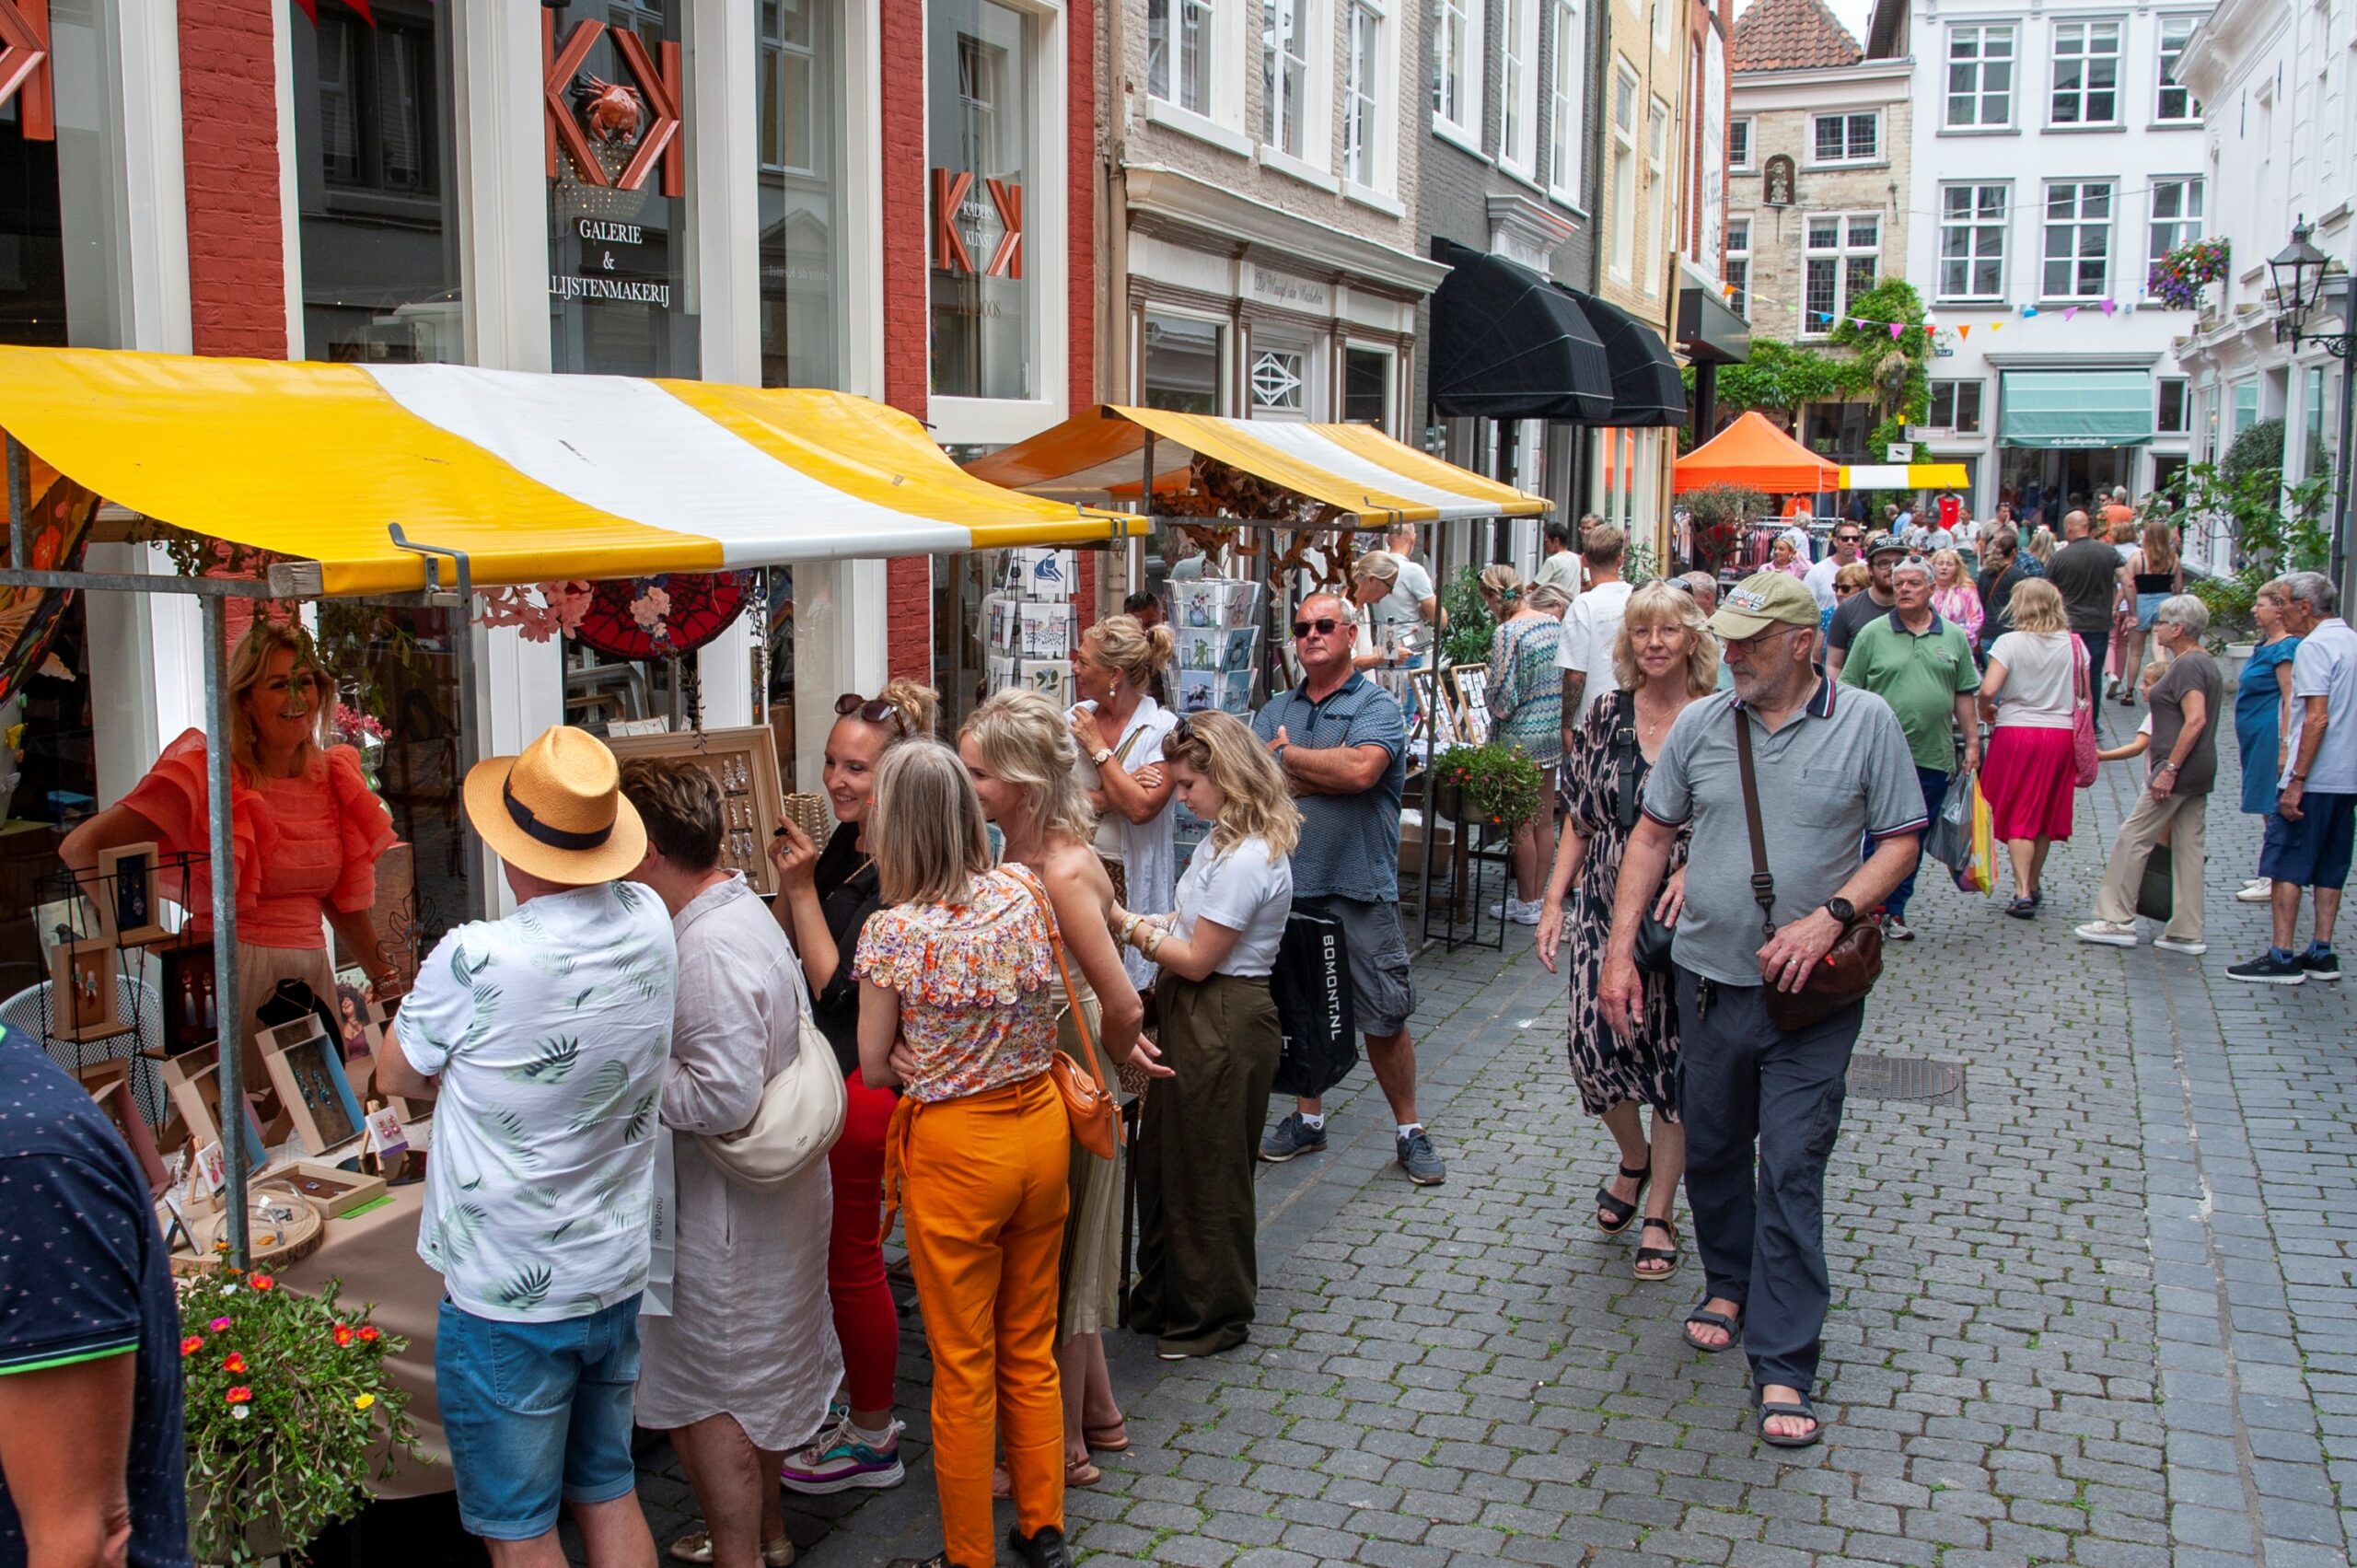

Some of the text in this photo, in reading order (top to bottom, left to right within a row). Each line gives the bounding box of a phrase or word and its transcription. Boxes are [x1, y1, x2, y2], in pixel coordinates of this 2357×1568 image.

[963, 200, 994, 220] KADERS
[579, 219, 643, 244] GALERIE
[966, 229, 994, 249] KUNST
[603, 250, 615, 270] &
[552, 275, 669, 308] LIJSTENMAKERIJ
[1323, 935, 1341, 1041] BOMONT.NL
